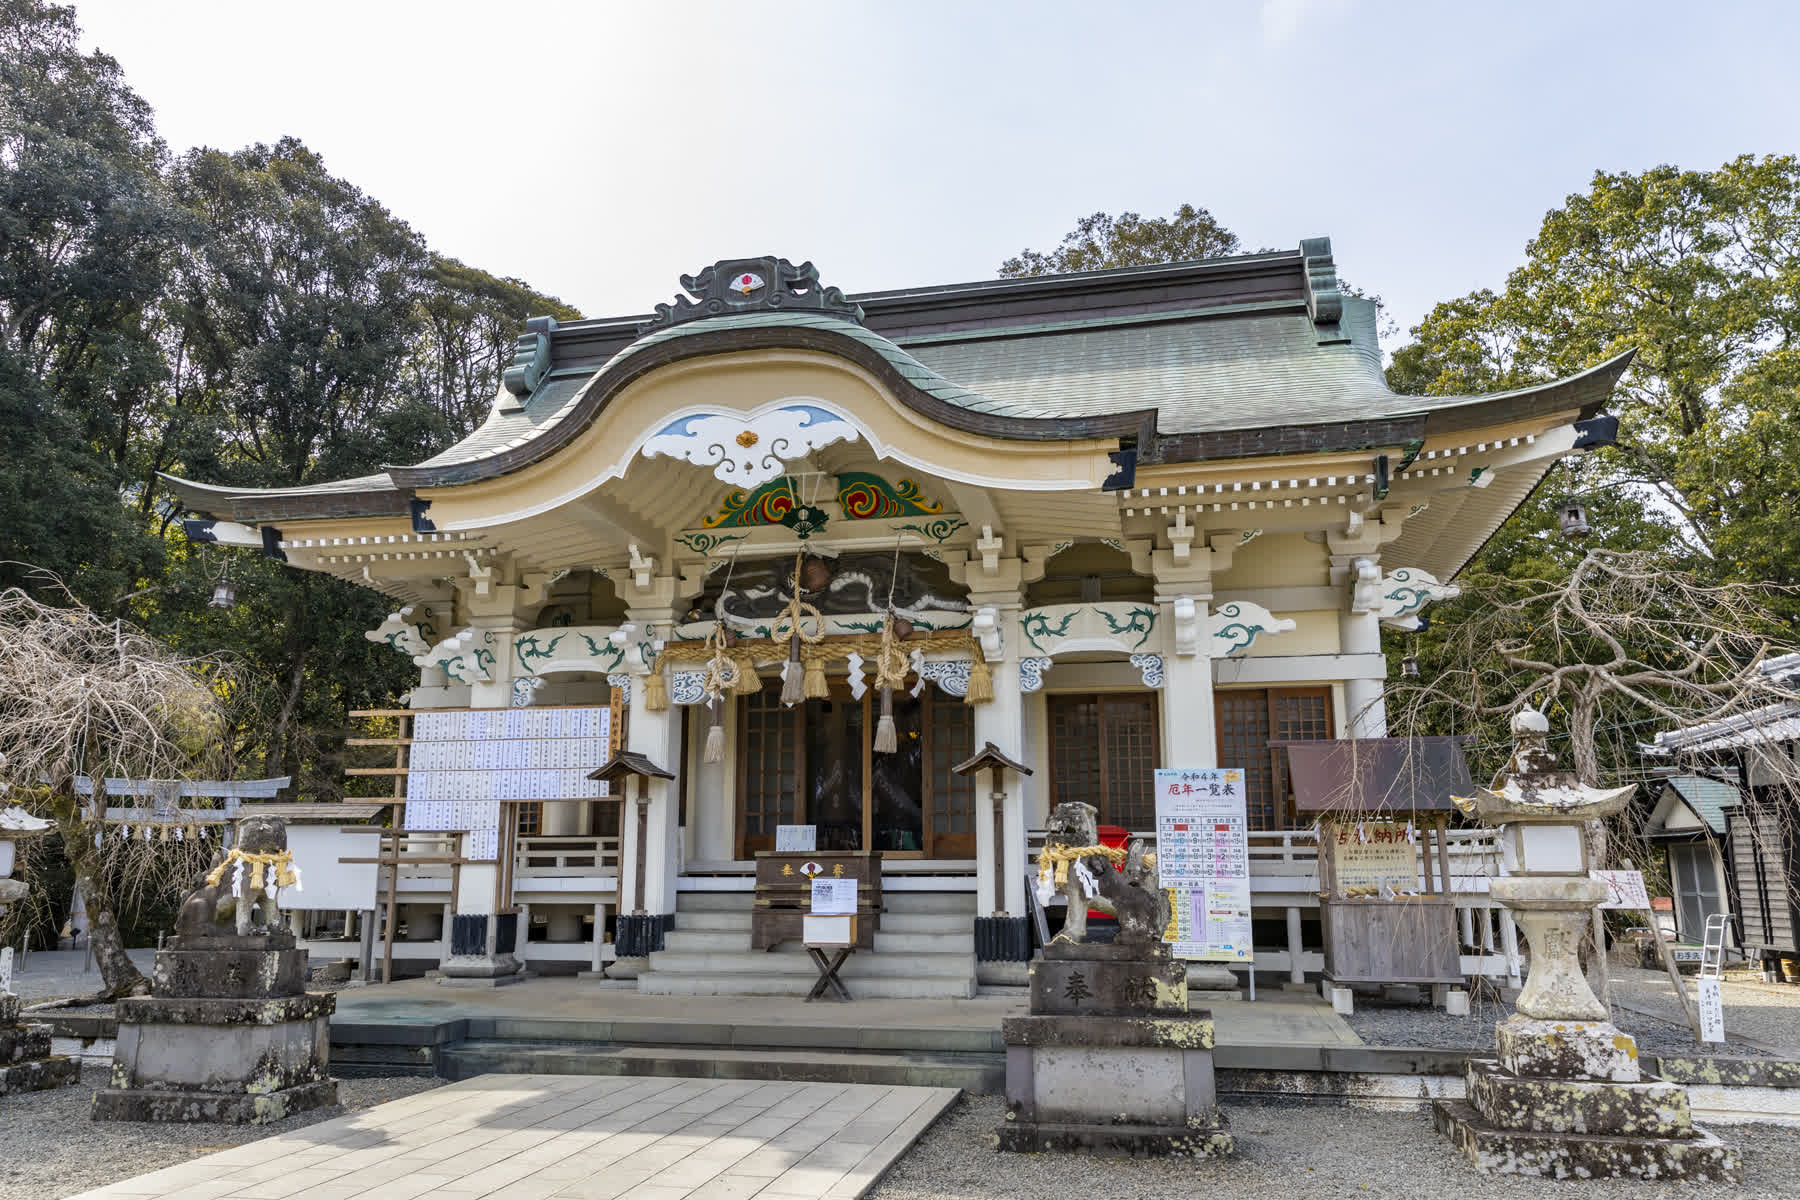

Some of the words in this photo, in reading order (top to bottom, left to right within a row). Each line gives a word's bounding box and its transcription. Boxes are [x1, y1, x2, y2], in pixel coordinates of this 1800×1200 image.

[1182, 772, 1219, 782] 令和4年
[1168, 783, 1236, 797] 厄年一覧表
[1677, 951, 1703, 960] お手洗
